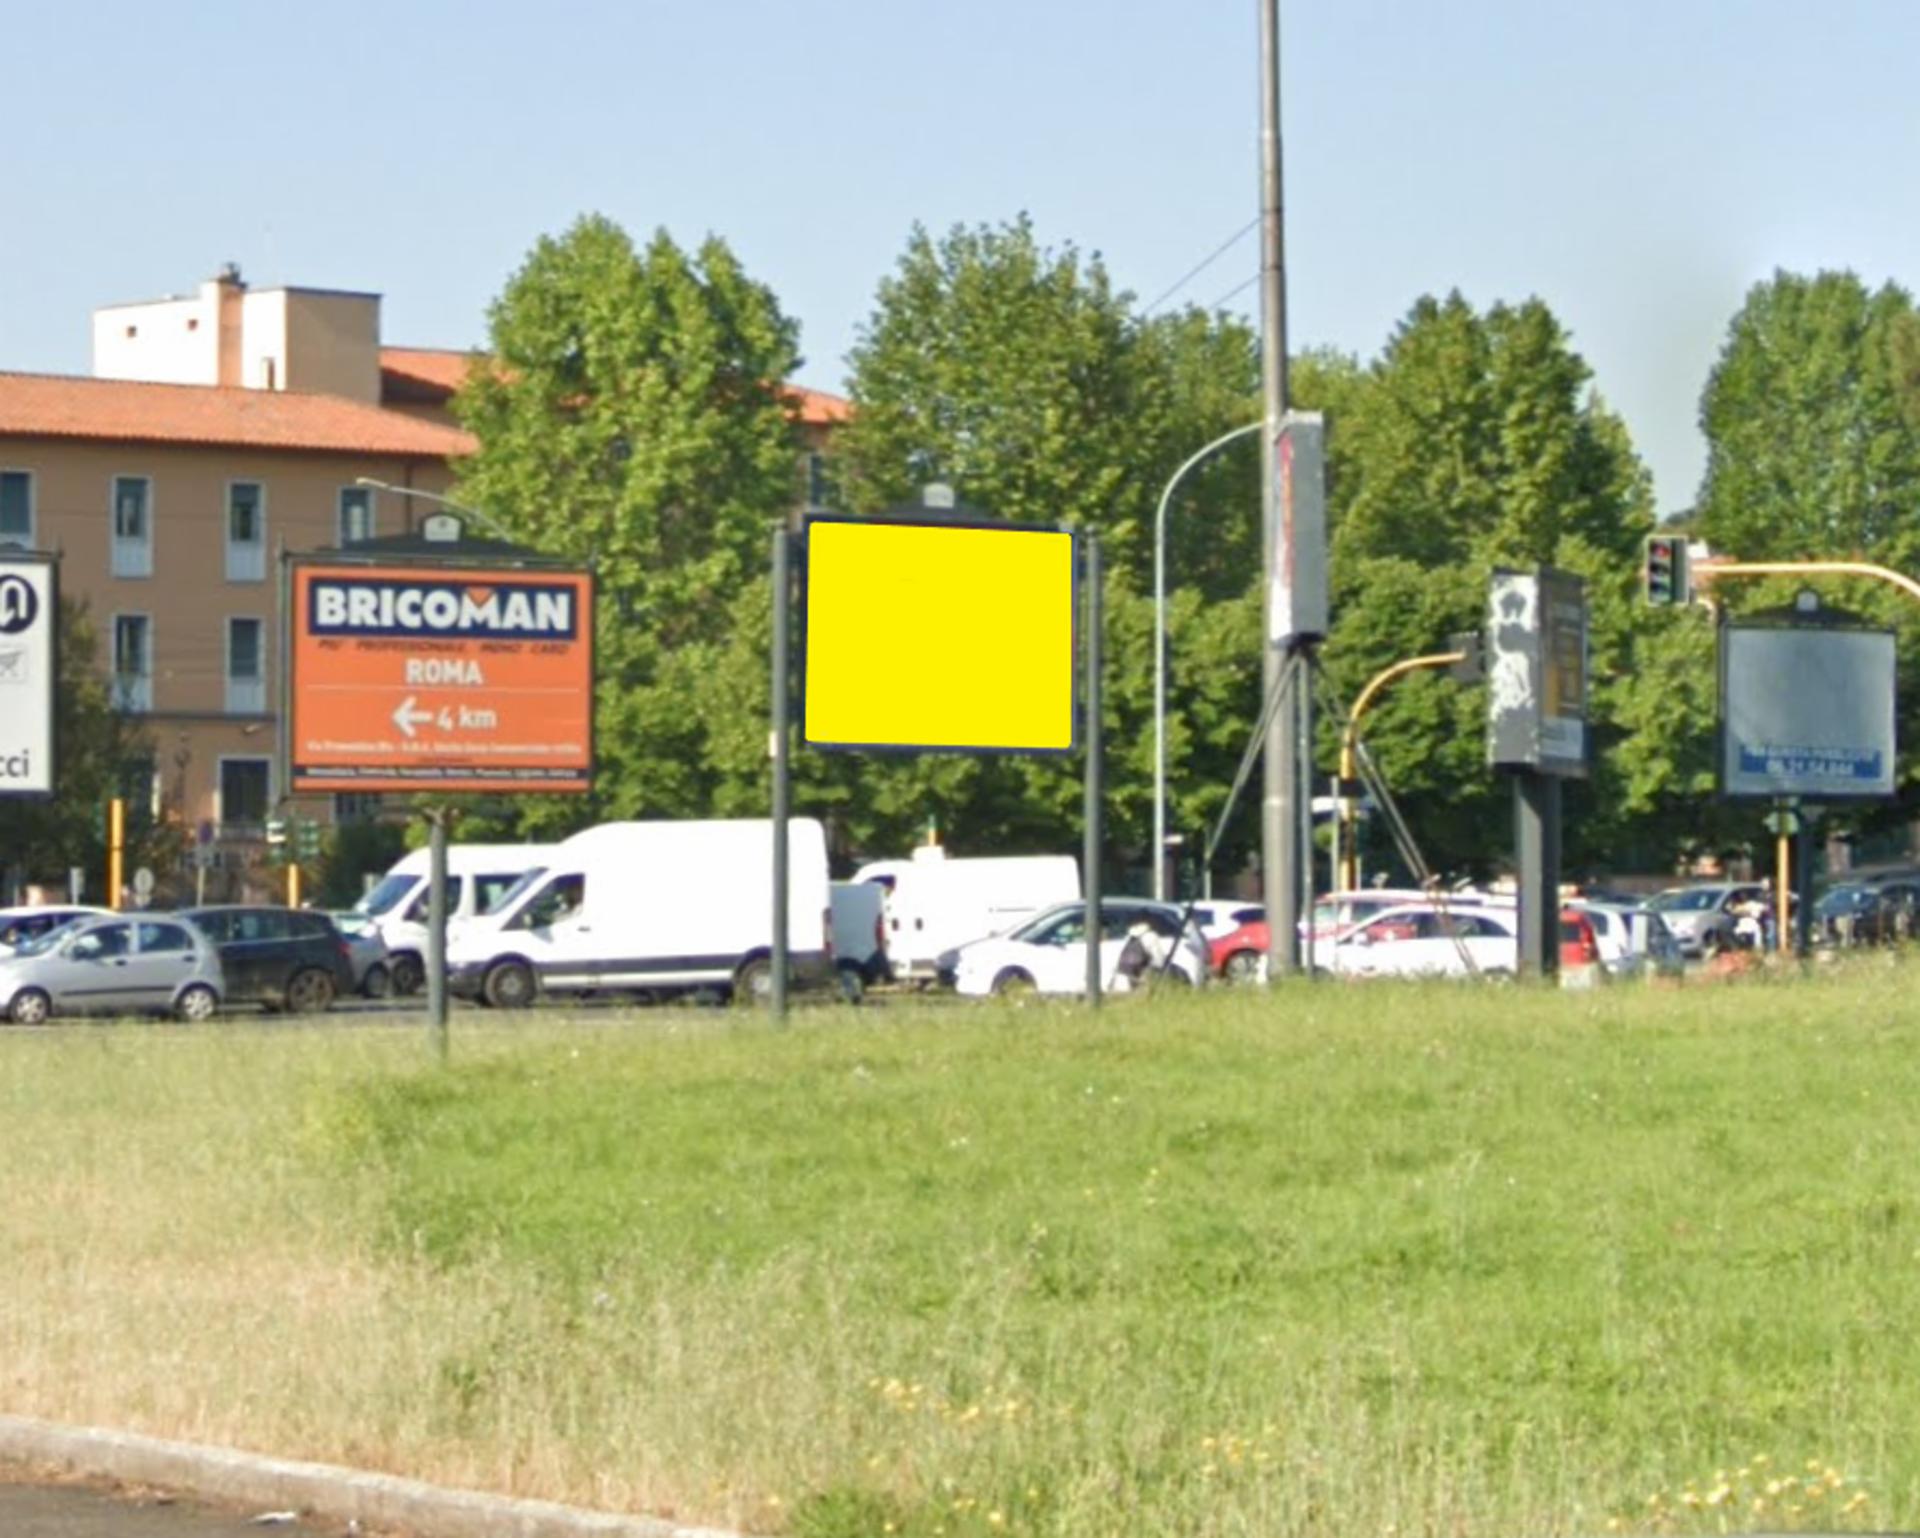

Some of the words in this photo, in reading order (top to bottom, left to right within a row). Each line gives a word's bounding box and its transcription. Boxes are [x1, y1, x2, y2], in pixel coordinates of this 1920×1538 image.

[315, 586, 570, 631] BRICOMAN
[405, 658, 483, 685] ROMA
[436, 706, 453, 731] 4
[459, 705, 496, 730] km
